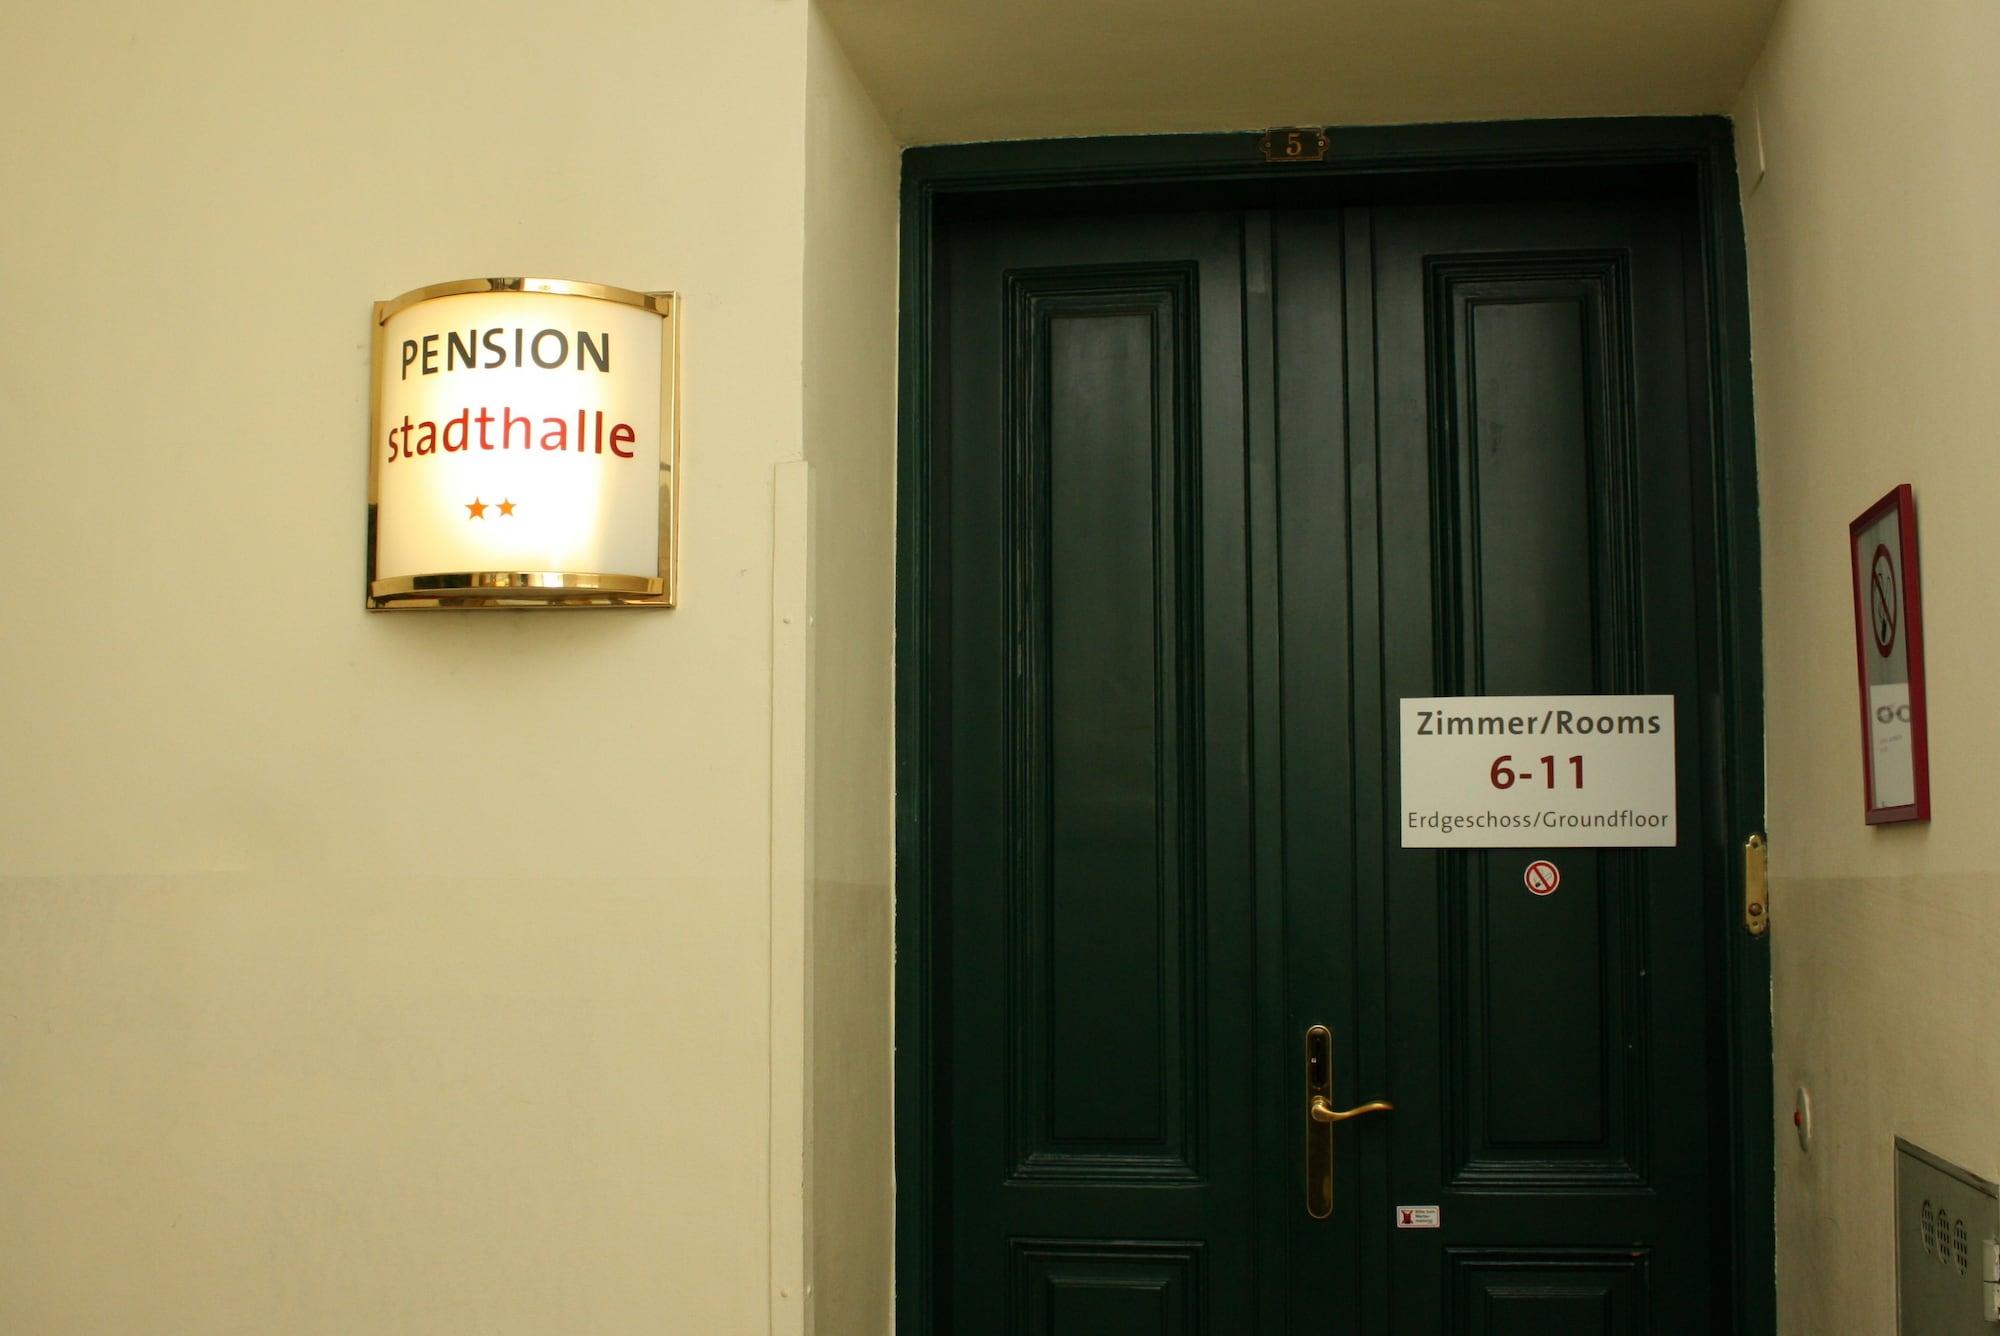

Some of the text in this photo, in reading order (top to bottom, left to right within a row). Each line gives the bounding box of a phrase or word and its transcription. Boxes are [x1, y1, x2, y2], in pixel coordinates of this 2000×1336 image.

[1287, 133, 1302, 156] 5
[402, 328, 610, 380] PENSION
[388, 407, 636, 464] stadthalle
[1416, 710, 1662, 736] Zimmer/Rooms
[1489, 754, 1585, 790] 6-11
[1407, 811, 1669, 834] Erdgeschoss/Groundfloor
